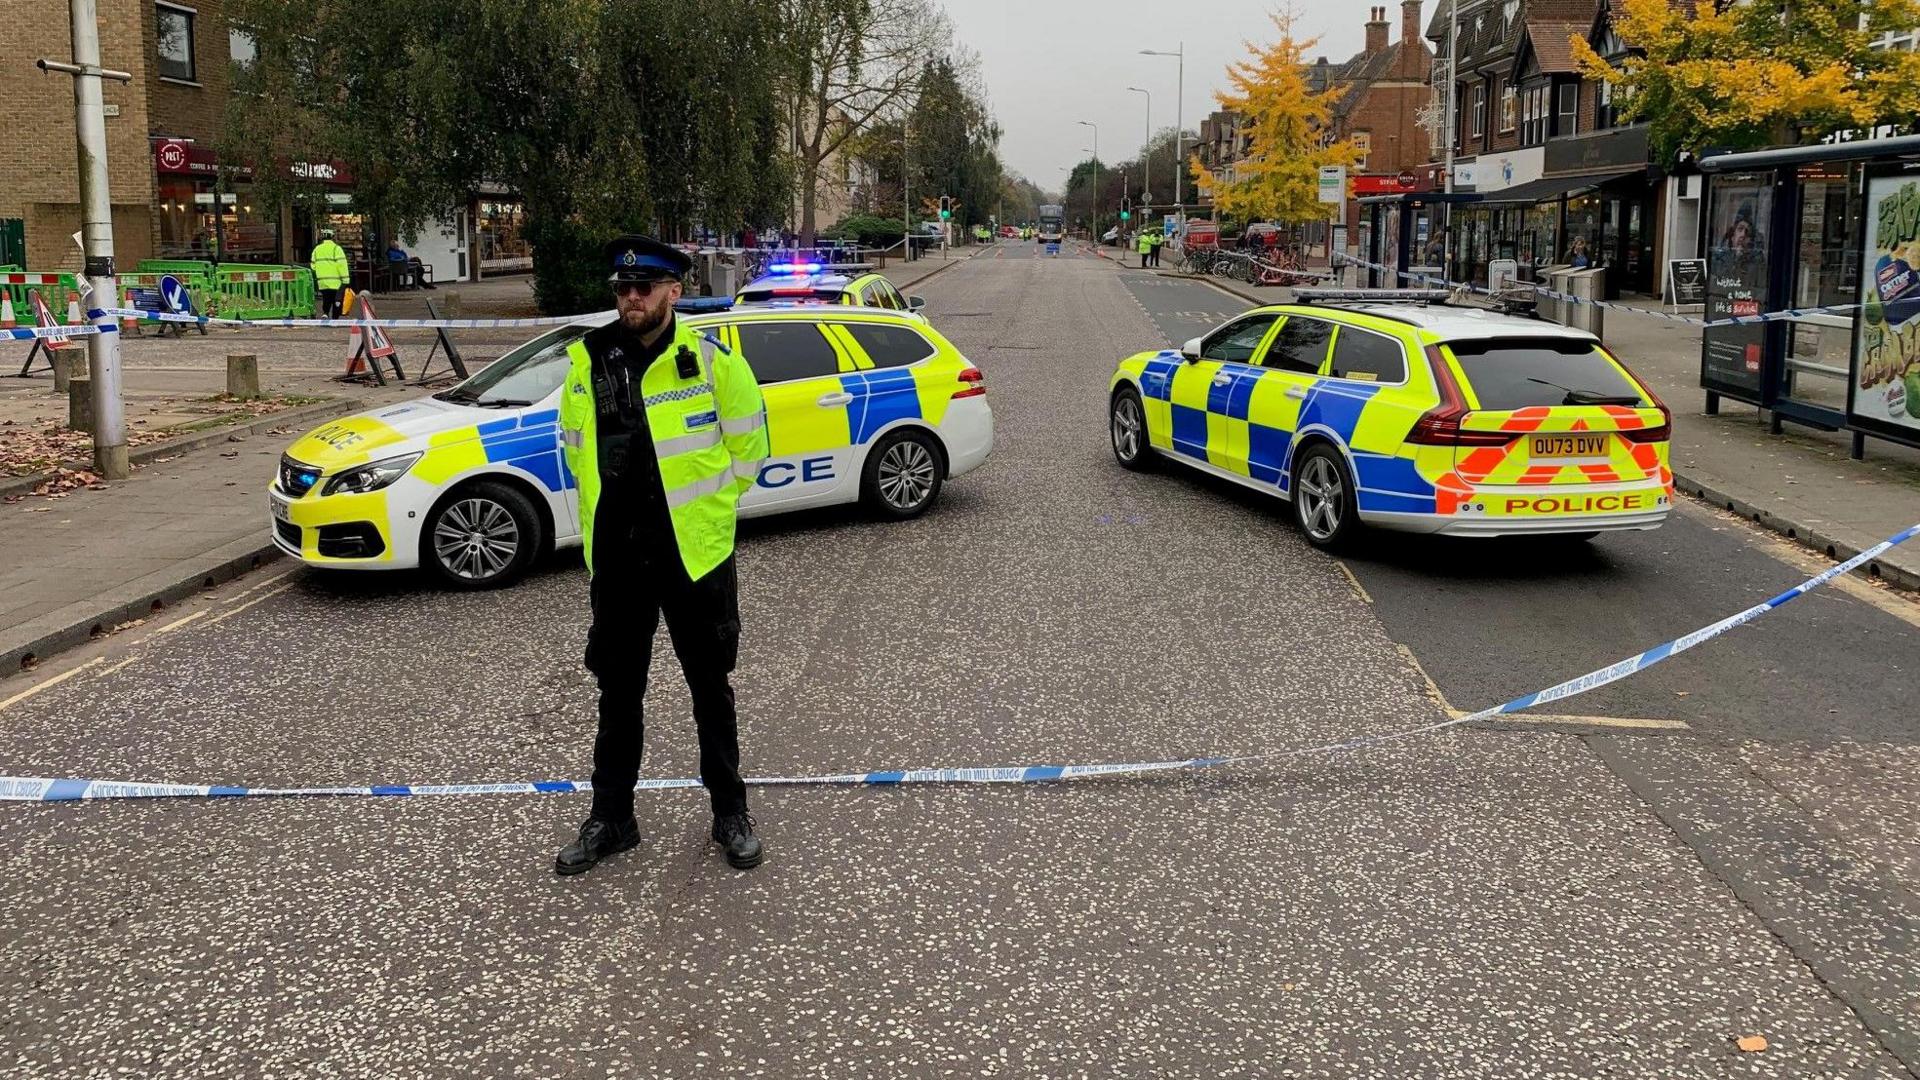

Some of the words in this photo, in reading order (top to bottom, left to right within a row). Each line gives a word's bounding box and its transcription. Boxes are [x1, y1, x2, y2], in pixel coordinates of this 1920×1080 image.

[1535, 439, 1574, 454] OU73
[1577, 438, 1604, 453] DVV
[1505, 494, 1642, 514] POLICE
[499, 783, 529, 791] CROSS
